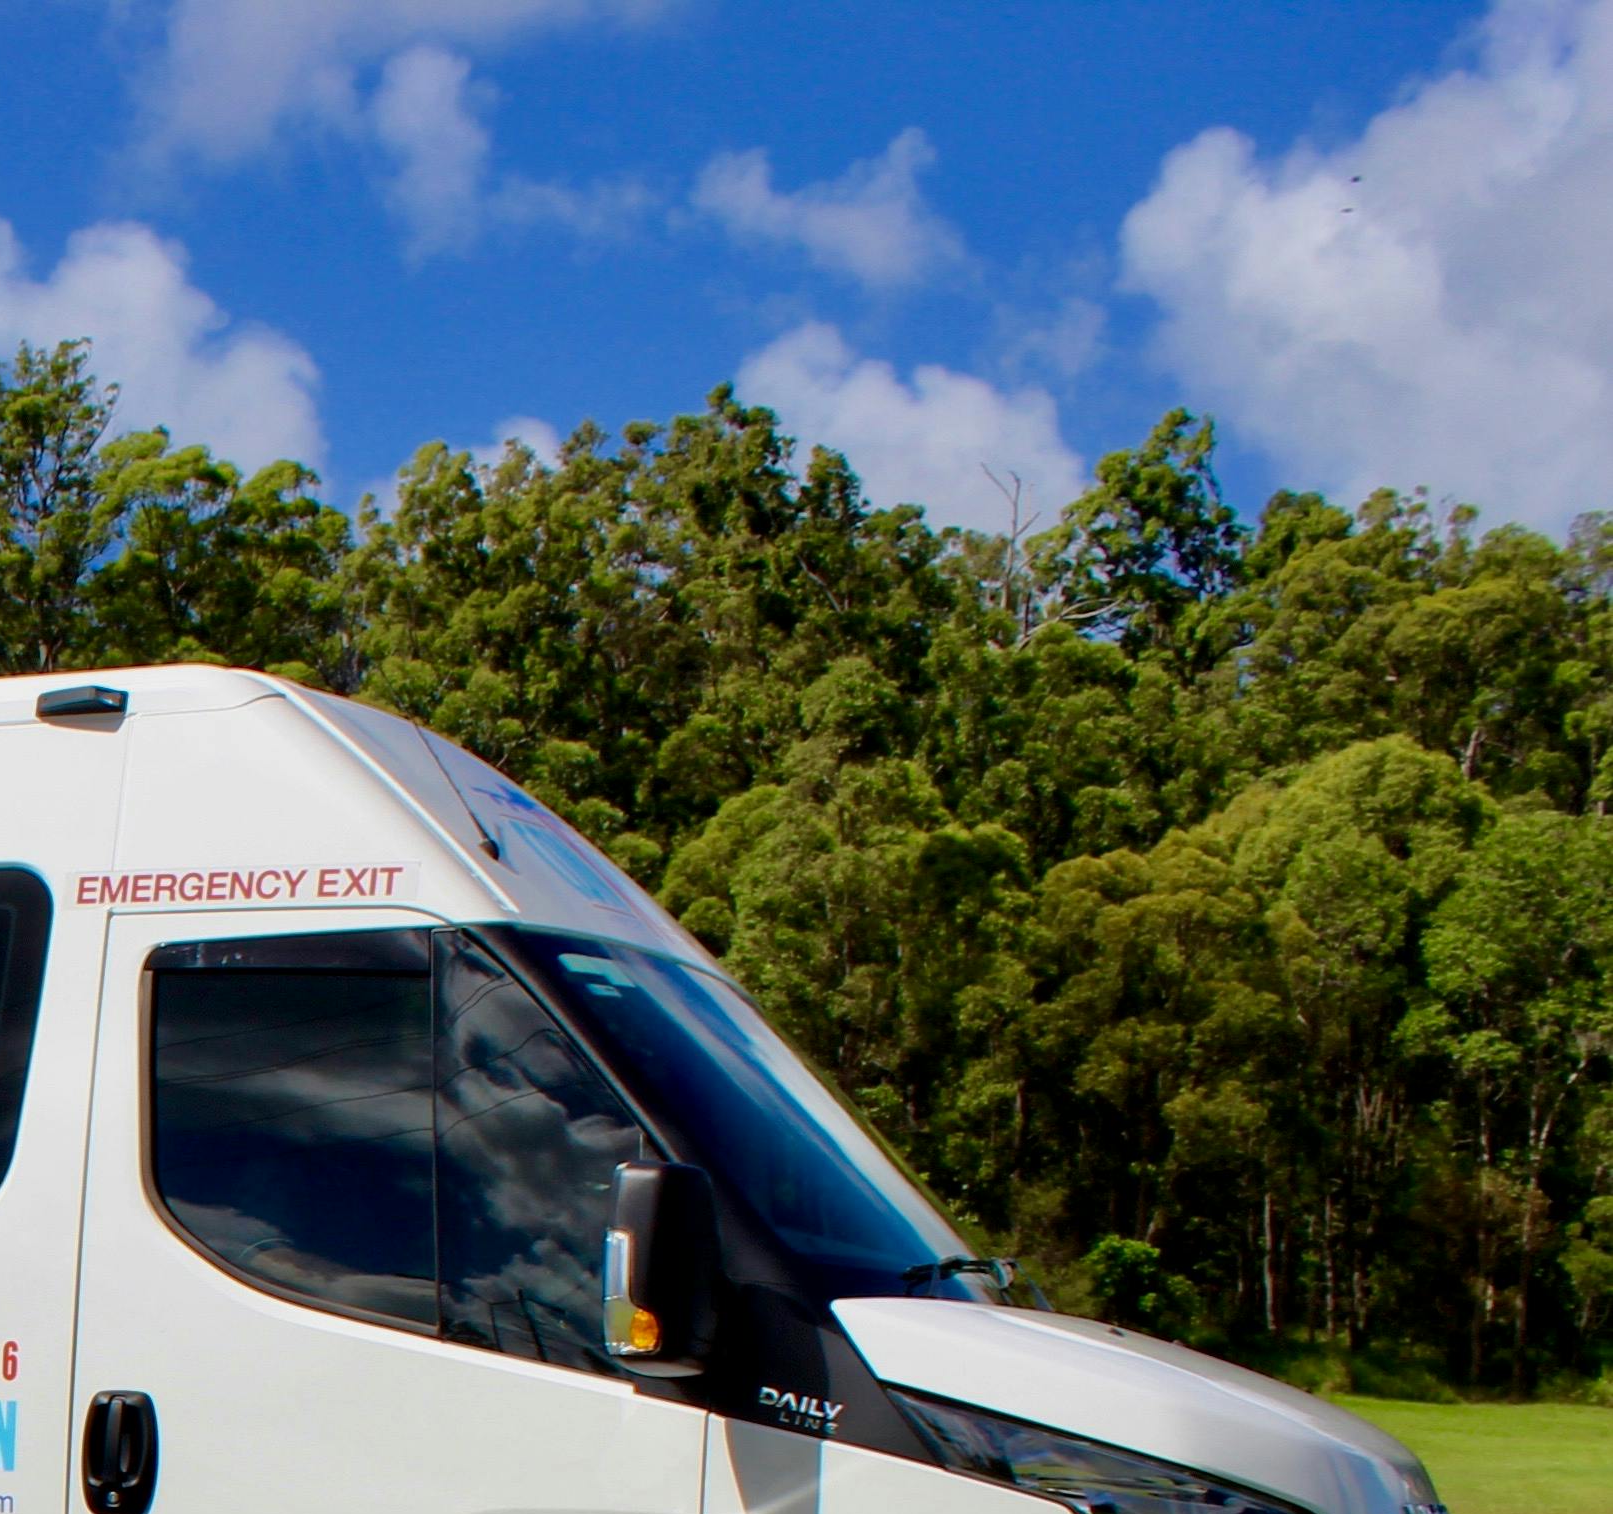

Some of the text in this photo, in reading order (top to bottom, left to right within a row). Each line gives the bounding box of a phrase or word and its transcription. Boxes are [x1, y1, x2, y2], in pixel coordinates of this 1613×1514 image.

[76, 866, 404, 905] EMERGENCY EXIT
[758, 1386, 843, 1421] DAILY
[780, 1411, 840, 1436] LINE
